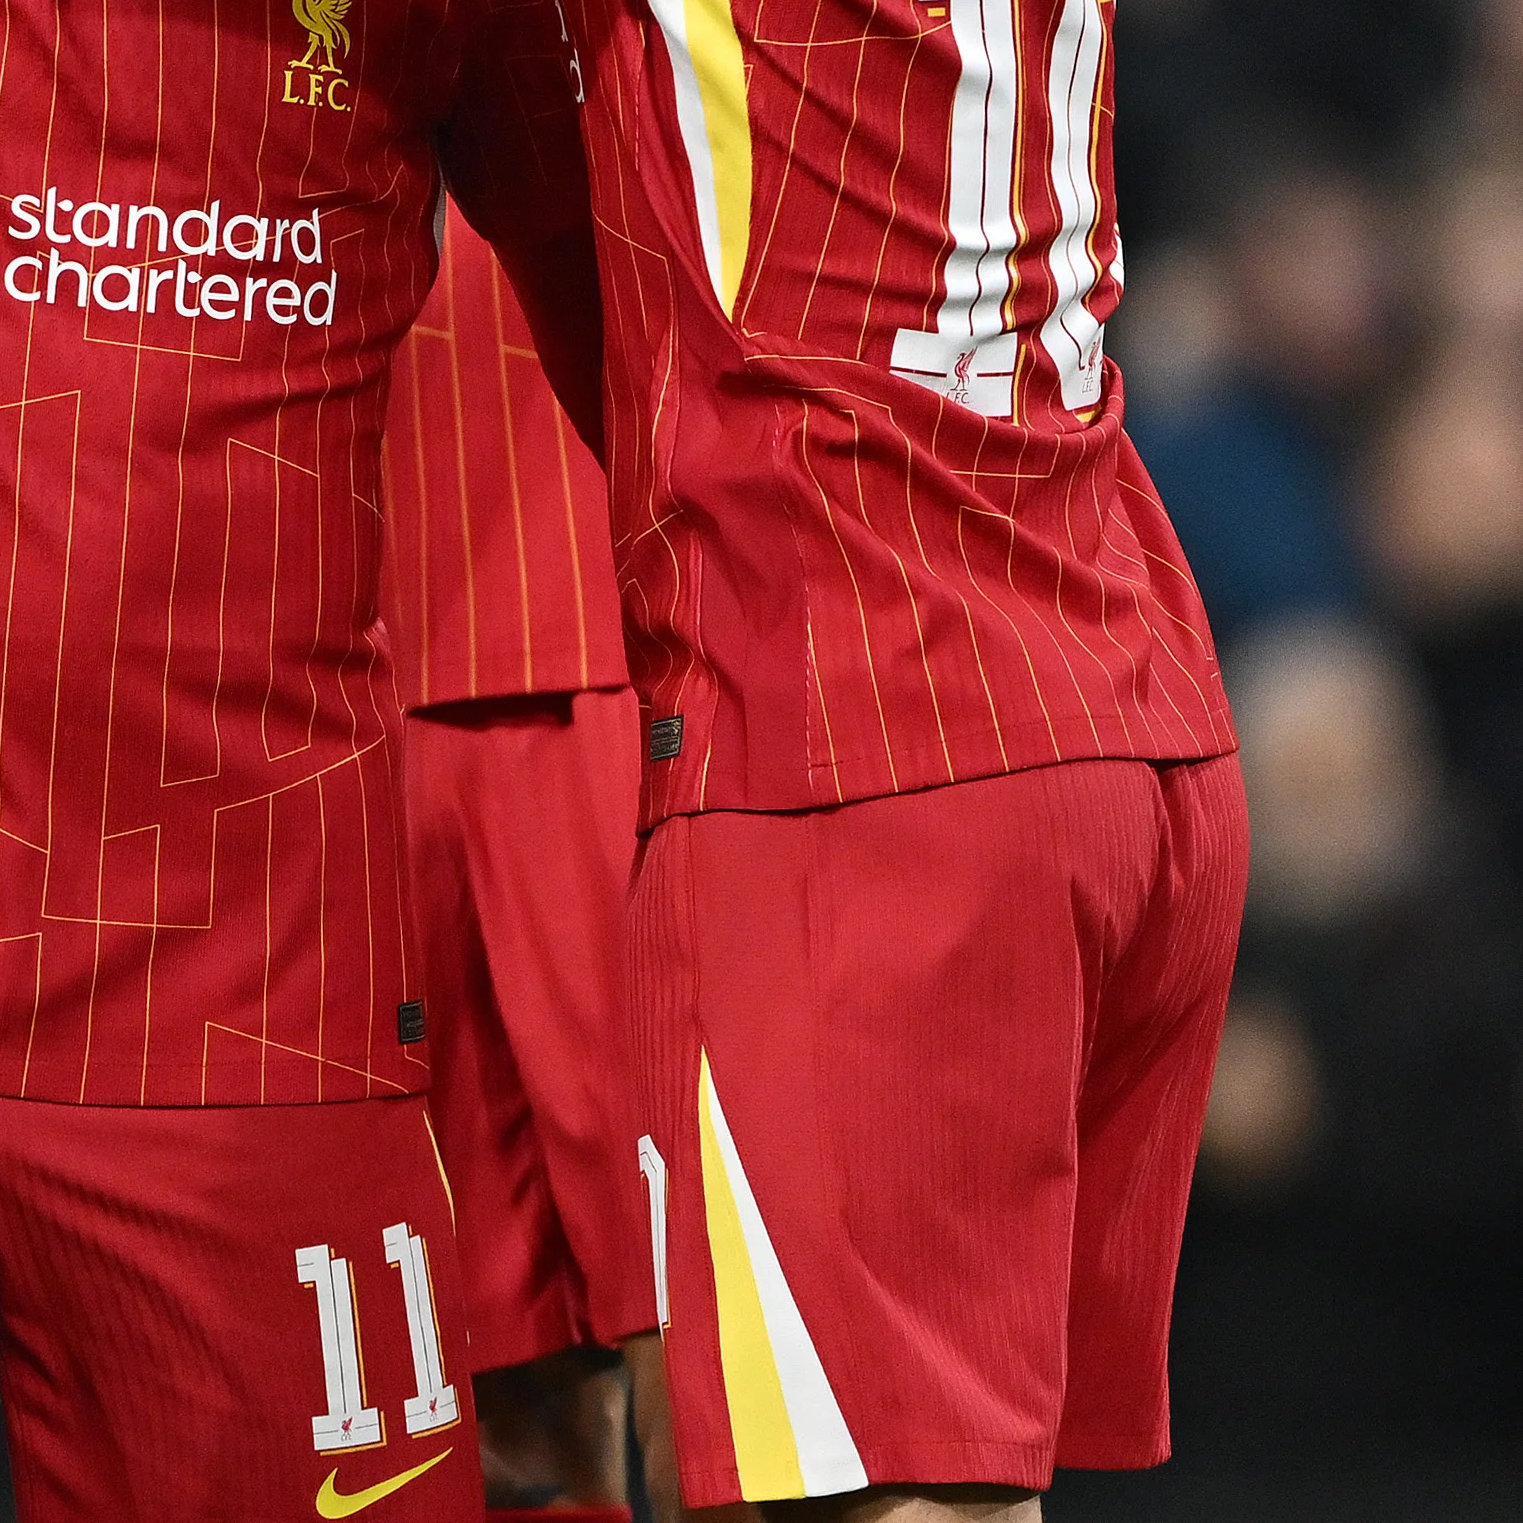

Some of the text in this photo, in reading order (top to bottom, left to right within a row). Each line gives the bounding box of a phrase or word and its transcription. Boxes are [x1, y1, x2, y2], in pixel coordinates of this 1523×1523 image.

[7, 186, 323, 264] standard
[4, 247, 338, 326] chartered
[295, 1222, 458, 1451] 11
